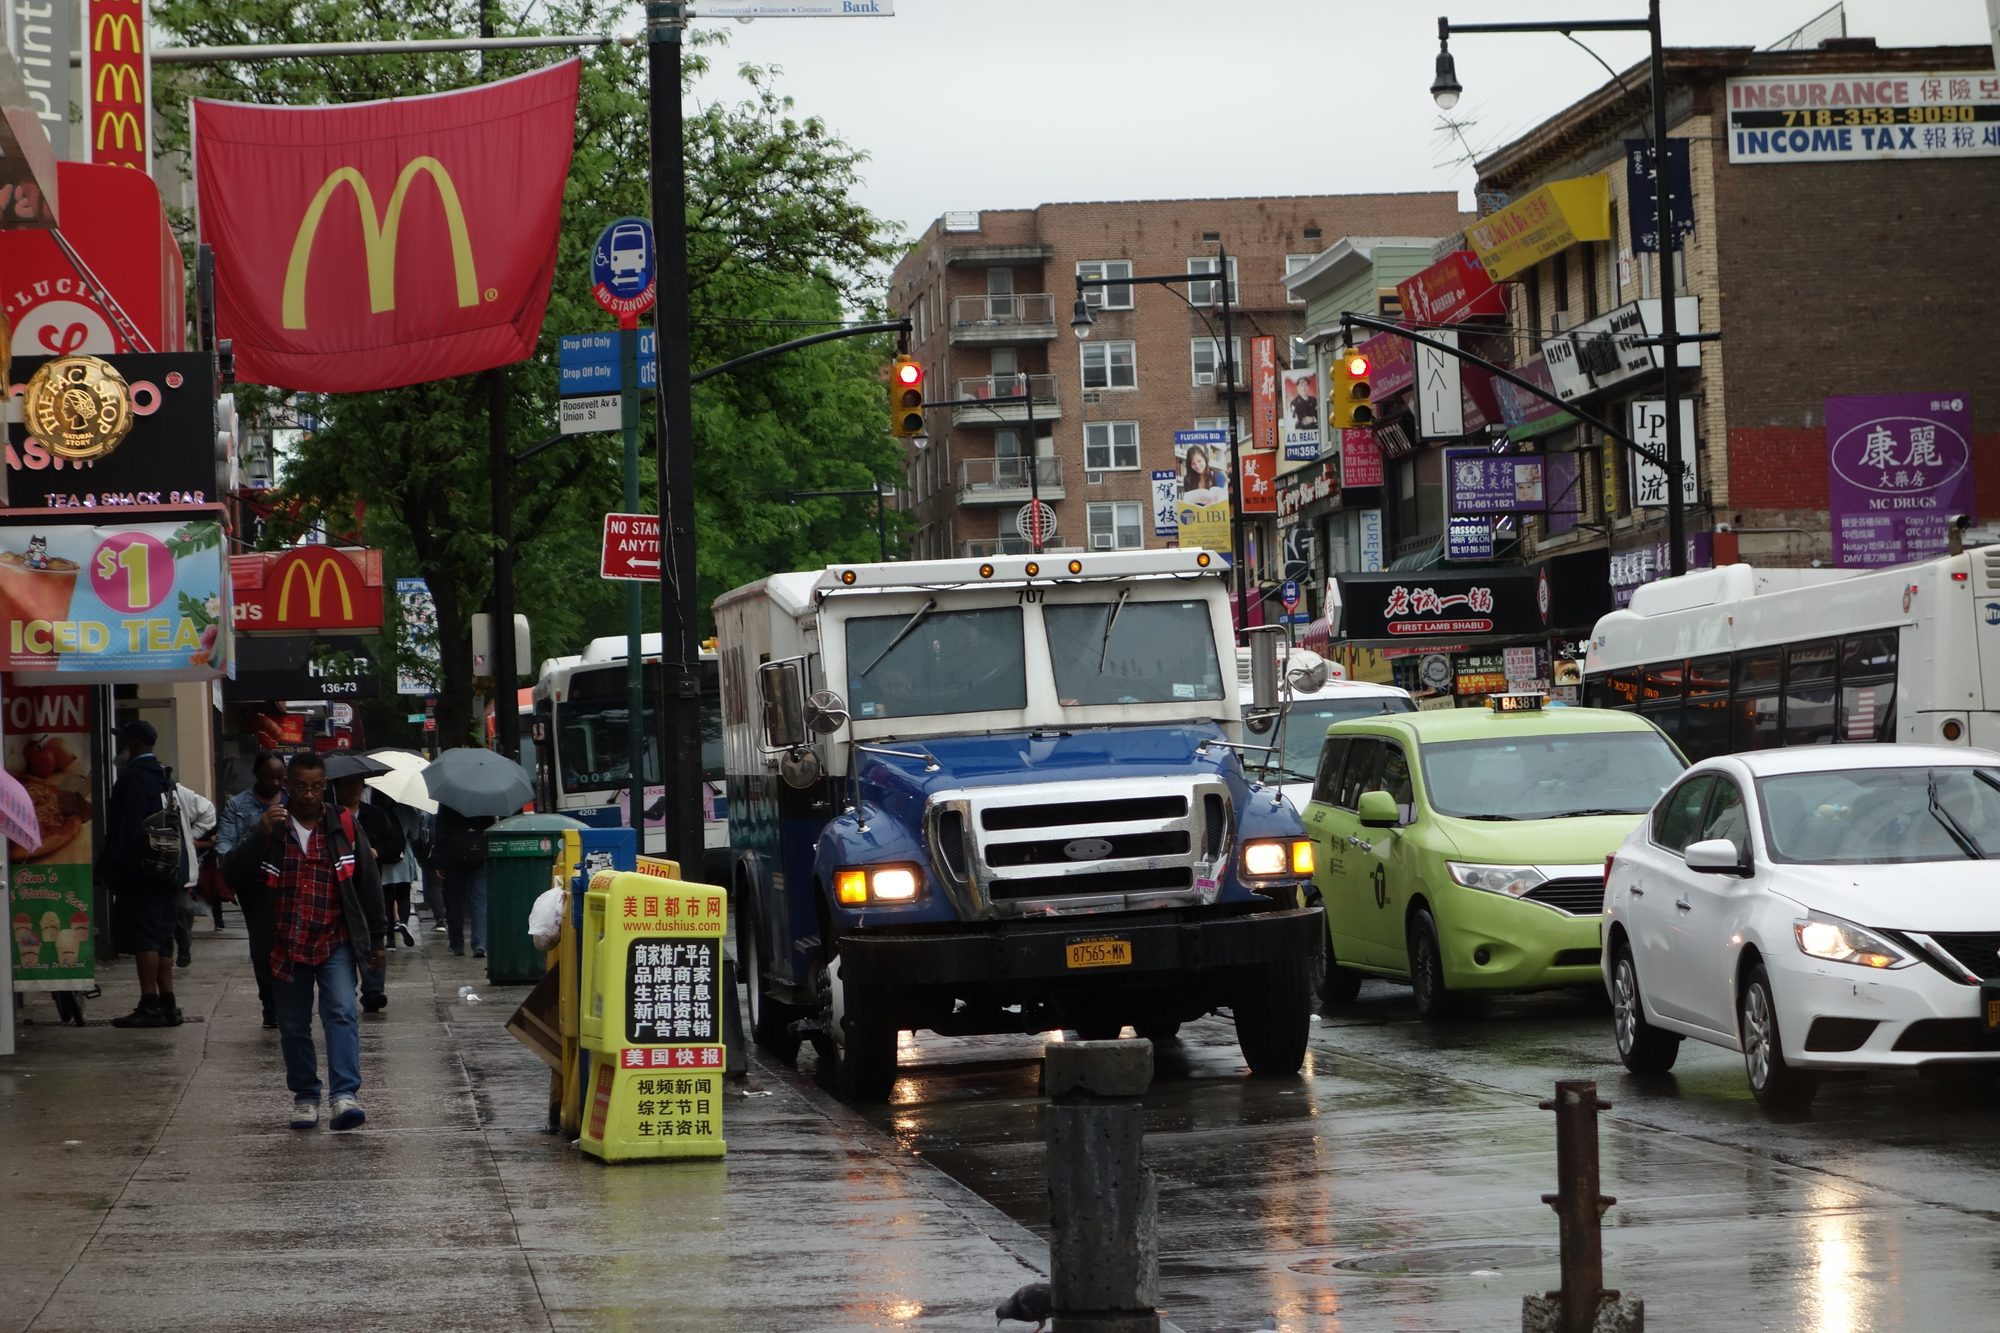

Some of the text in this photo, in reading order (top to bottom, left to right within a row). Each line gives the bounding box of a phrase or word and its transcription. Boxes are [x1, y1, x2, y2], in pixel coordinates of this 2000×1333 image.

[842, 0, 881, 13] Bank
[15, 0, 63, 143] print
[1731, 81, 1909, 109] INSURANCE
[1920, 78, 1972, 102] 保險
[1781, 105, 1975, 128] 718-353-9090
[1736, 128, 1853, 155] INCOME
[1861, 126, 1917, 150] TAX
[1922, 127, 1975, 150] 報稅
[15, 278, 107, 307] LUCIA
[597, 286, 610, 304] NO
[563, 338, 580, 351] Drop
[581, 337, 593, 349] Off
[594, 336, 611, 350] Only
[563, 367, 581, 380] Drop
[582, 366, 593, 378] Off
[594, 365, 611, 378] Only
[39, 395, 60, 436] THE
[93, 380, 117, 434] SHOP
[563, 397, 618, 411] Roosevelt Av &
[563, 410, 597, 422] Union St
[1638, 404, 1665, 439] IP
[62, 431, 94, 440] NATURAL
[65, 439, 91, 447] STORY
[1180, 432, 1221, 441] FLUSHING BID
[1858, 424, 1944, 470] 康麗
[1681, 462, 1696, 501] 美甲
[1878, 469, 1926, 488] 大藥房
[44, 493, 81, 509] TEA
[101, 491, 161, 506] SNACK
[169, 489, 205, 505] BAR
[1869, 496, 1938, 510] MC DRUGS
[611, 521, 627, 535] NO
[1905, 515, 1925, 526] Copy
[1450, 525, 1490, 535] SASSOON
[1905, 527, 1922, 537] OTC
[1467, 535, 1490, 544] SALON
[1843, 553, 1863, 564] DMV
[97, 542, 150, 609] $1
[1015, 589, 1046, 604] 707
[1396, 620, 1485, 632] FIRST LAMB SHABU
[10, 617, 201, 654] ICED TEA
[308, 657, 370, 678] HAR
[1470, 674, 1486, 683] SPA
[1513, 681, 1532, 689] JUN
[320, 682, 358, 694] 136-73
[1502, 694, 1536, 711] BA381
[577, 808, 598, 816] 4202
[623, 896, 721, 918] 美国都市网
[623, 919, 721, 932] www.dushius.com
[635, 944, 711, 967] 商家推广平台
[634, 966, 711, 984] 品牌商家
[634, 985, 712, 1001] 生活信息
[634, 1002, 712, 1020] 新闻资讯
[634, 1020, 712, 1038] 广告营销
[625, 1048, 720, 1067] 美国快报
[637, 1078, 712, 1096] 视频新闻
[637, 1099, 710, 1116] 综艺节目
[637, 1119, 713, 1137] 生活资讯
